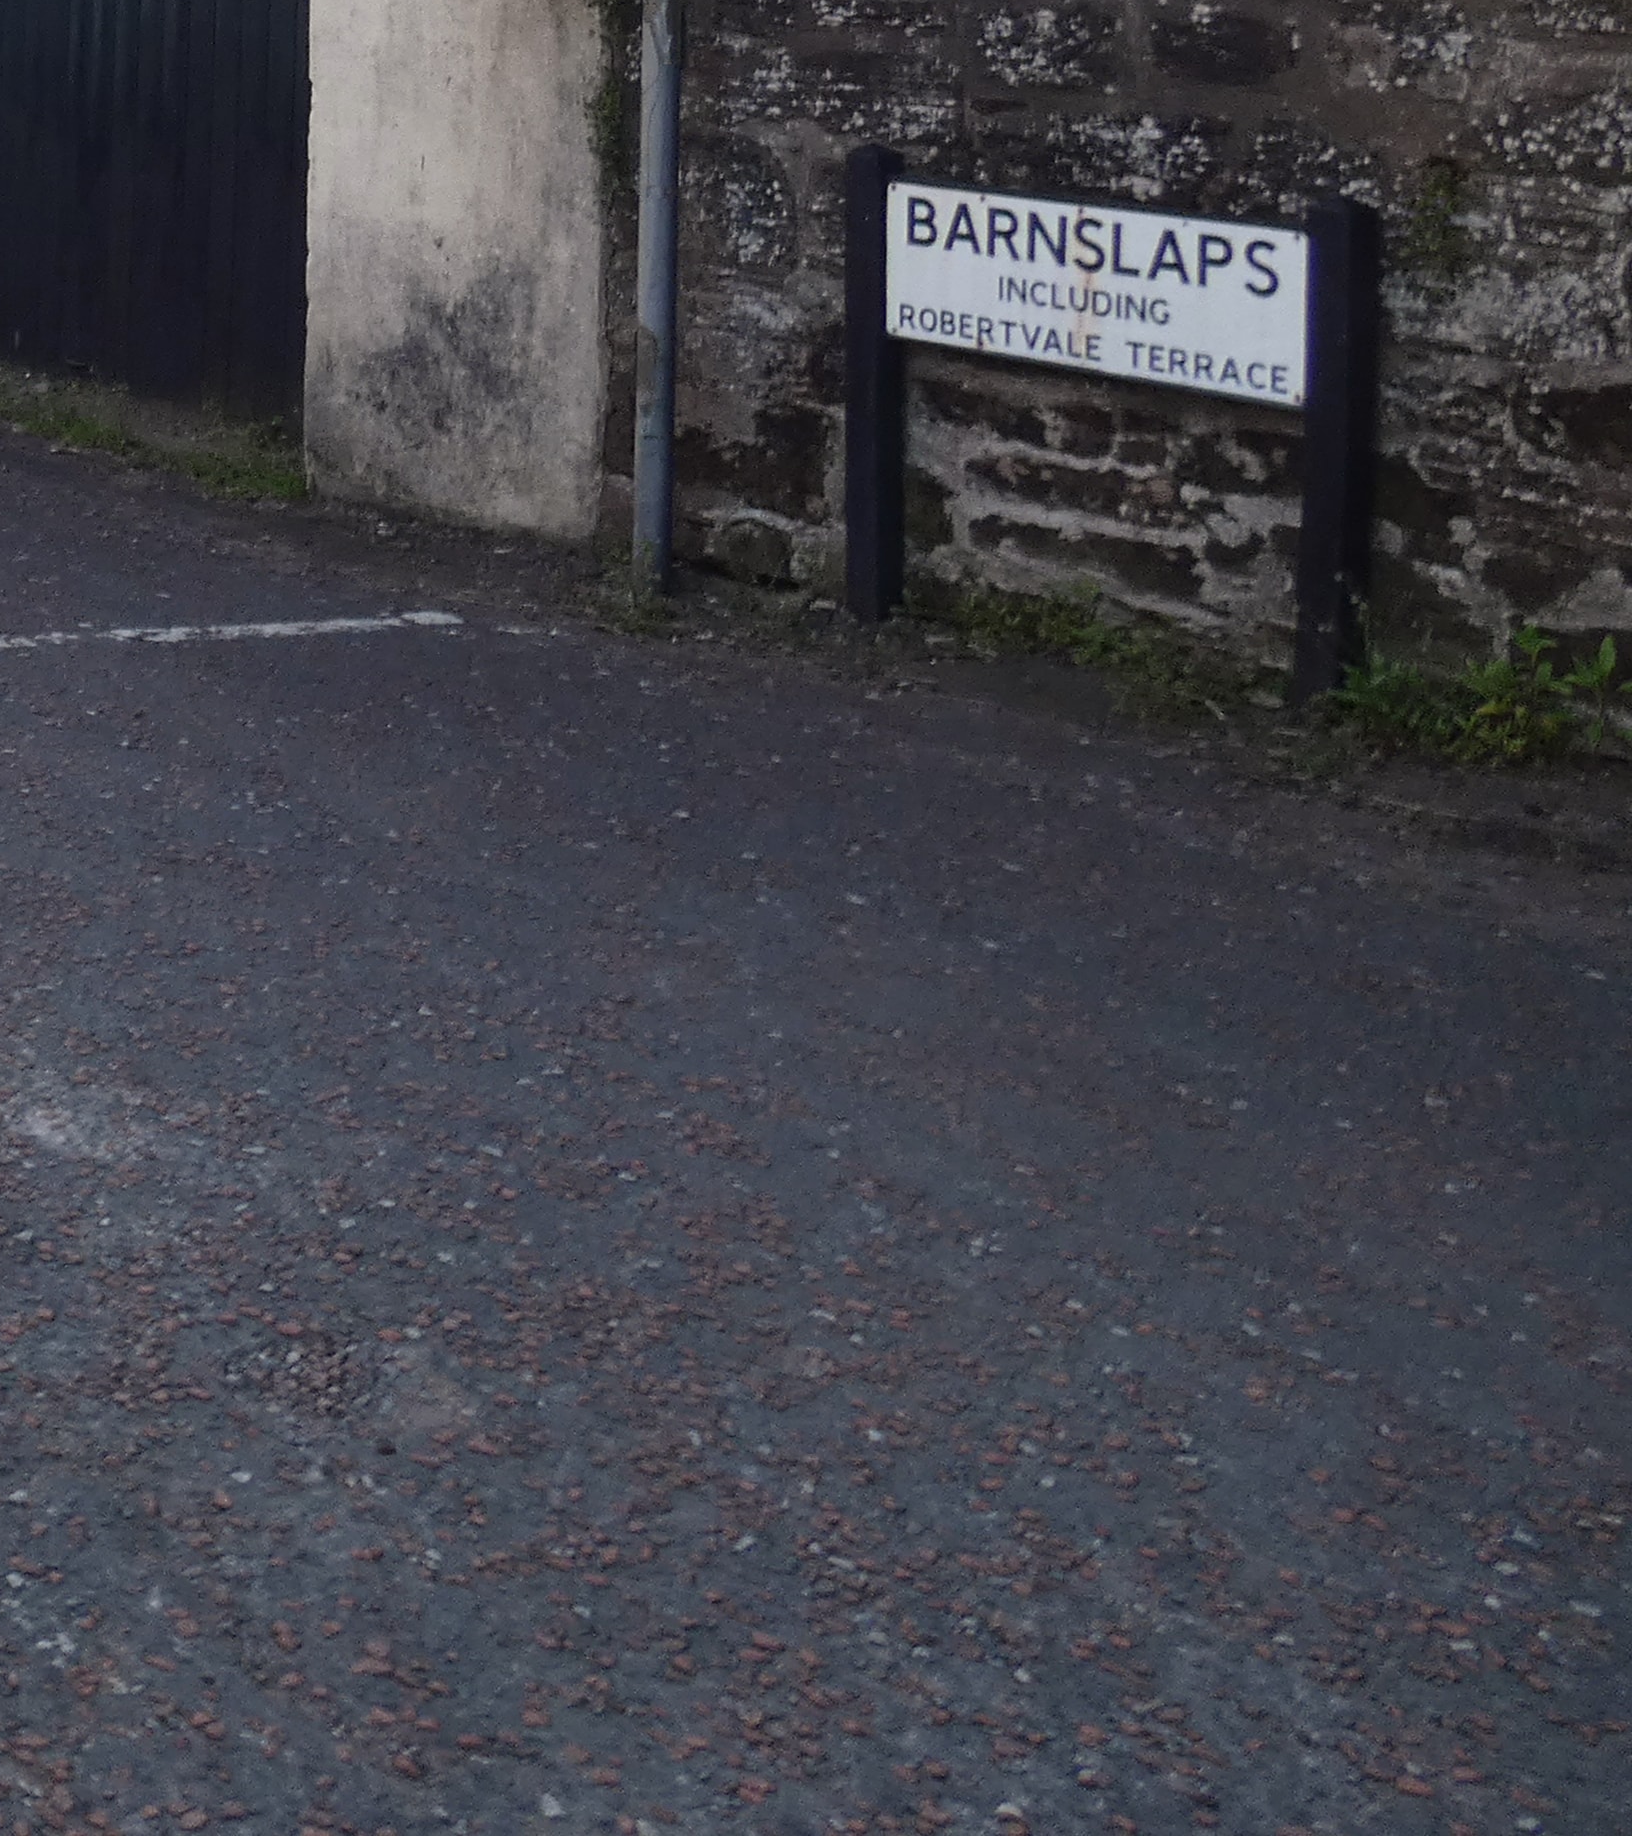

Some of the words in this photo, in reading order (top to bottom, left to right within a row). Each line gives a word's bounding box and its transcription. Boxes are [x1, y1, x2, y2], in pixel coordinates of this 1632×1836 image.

[905, 196, 1280, 299] BARNSLAPS
[997, 275, 1171, 326] INCLUDING
[898, 302, 1102, 362] ROBERTVALE
[1125, 340, 1289, 395] TERRACE
